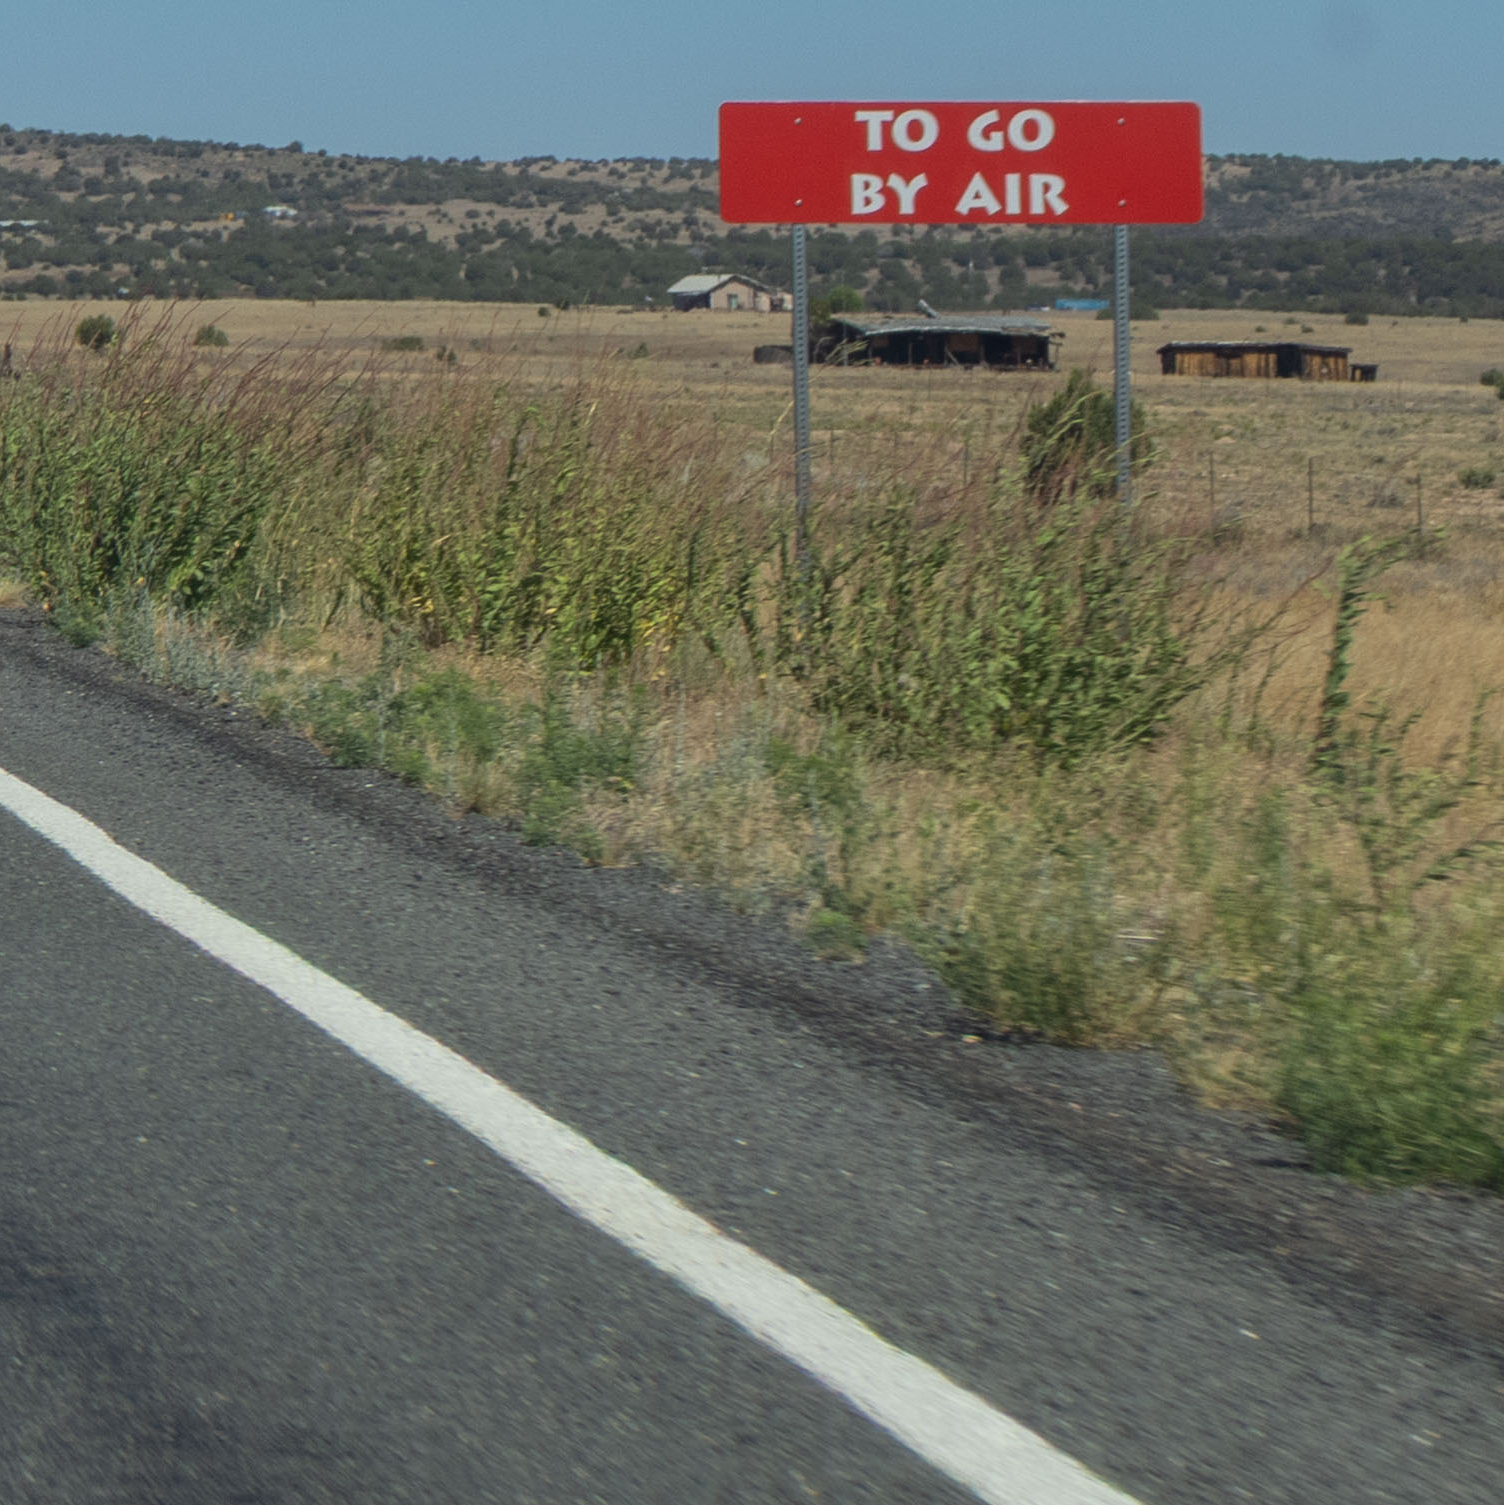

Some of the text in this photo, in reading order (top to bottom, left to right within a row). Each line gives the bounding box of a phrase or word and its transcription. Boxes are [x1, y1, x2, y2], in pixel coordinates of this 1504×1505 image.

[854, 109, 1055, 152] TO GO
[850, 172, 1069, 215] BY AIR
